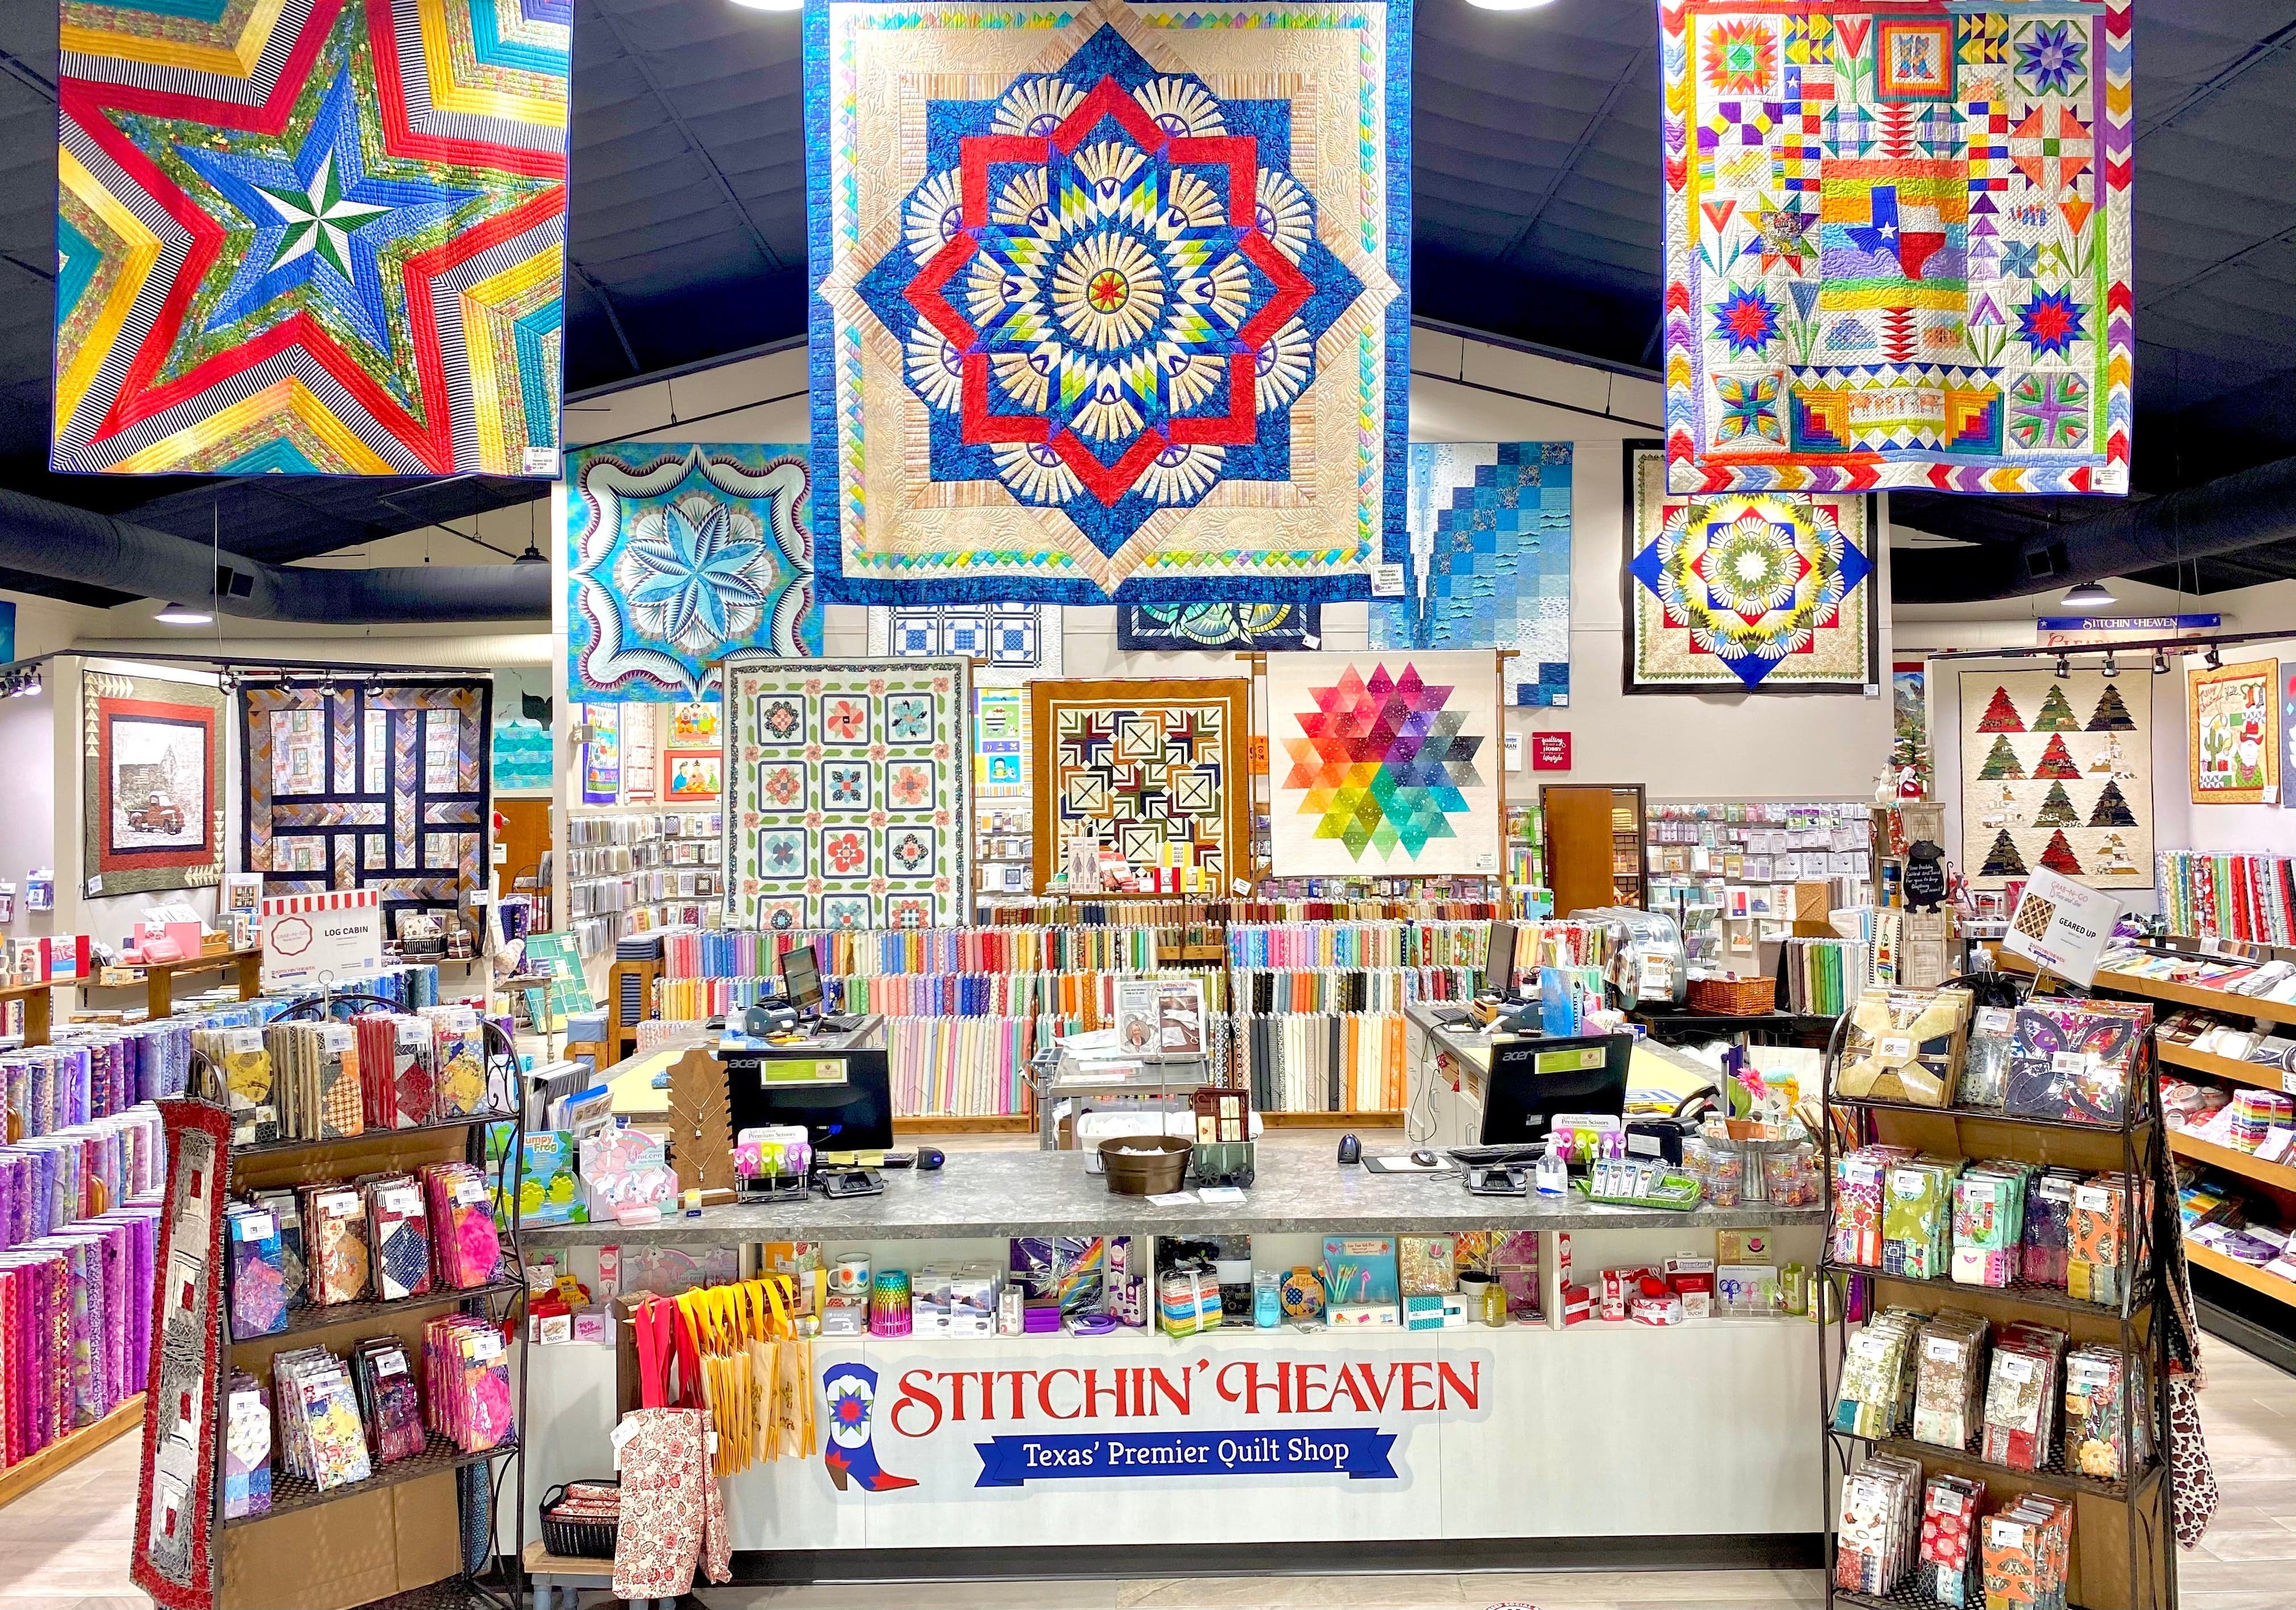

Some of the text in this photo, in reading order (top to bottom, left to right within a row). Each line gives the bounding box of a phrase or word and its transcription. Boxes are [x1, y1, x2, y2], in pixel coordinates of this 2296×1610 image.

[2133, 617, 2178, 628] HEAVEN
[1541, 735, 1566, 748] quilting
[1543, 754, 1563, 763] lifestyle
[325, 926, 368, 937] LOG CABIN
[2059, 917, 2096, 939] GEARED UP
[1502, 1050, 1532, 1062] acer
[729, 1059, 760, 1068] acer
[525, 1135, 553, 1145] umpy
[534, 1143, 557, 1153] Frog
[628, 1149, 662, 1163] Unicorn
[891, 1358, 1480, 1437] STITCHIN' HEAVEN
[1023, 1436, 1350, 1469] Texas' Premier Quilt Shop
